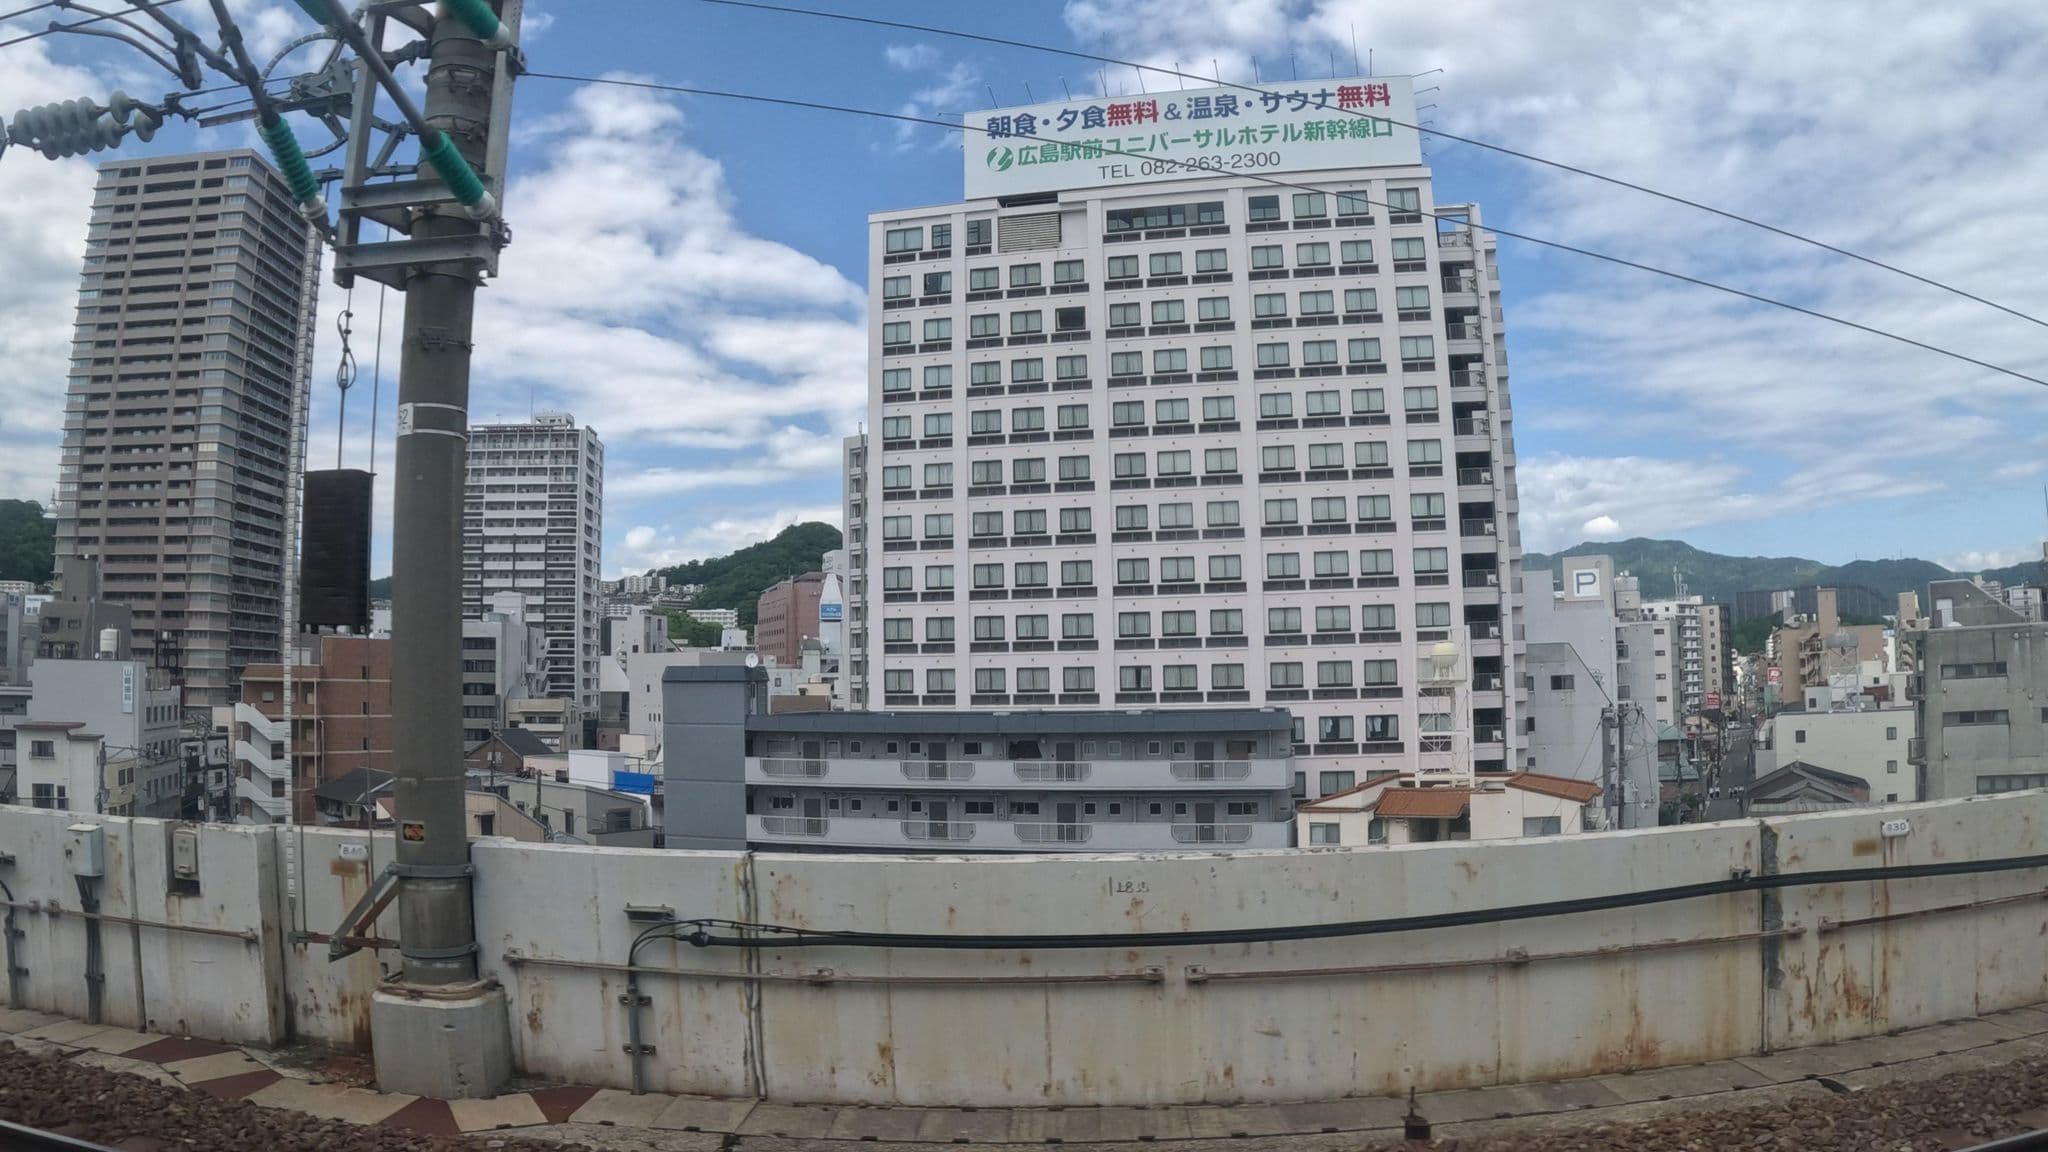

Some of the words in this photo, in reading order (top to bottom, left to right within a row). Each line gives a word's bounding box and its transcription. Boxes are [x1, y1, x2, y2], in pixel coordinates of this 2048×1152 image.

[1018, 118, 1393, 167] 広島駅前ユニバーサルホテル新幹線口
[1098, 164, 1135, 181] TEL
[1140, 151, 1281, 176] 082-263-2300
[1576, 572, 1597, 594] P
